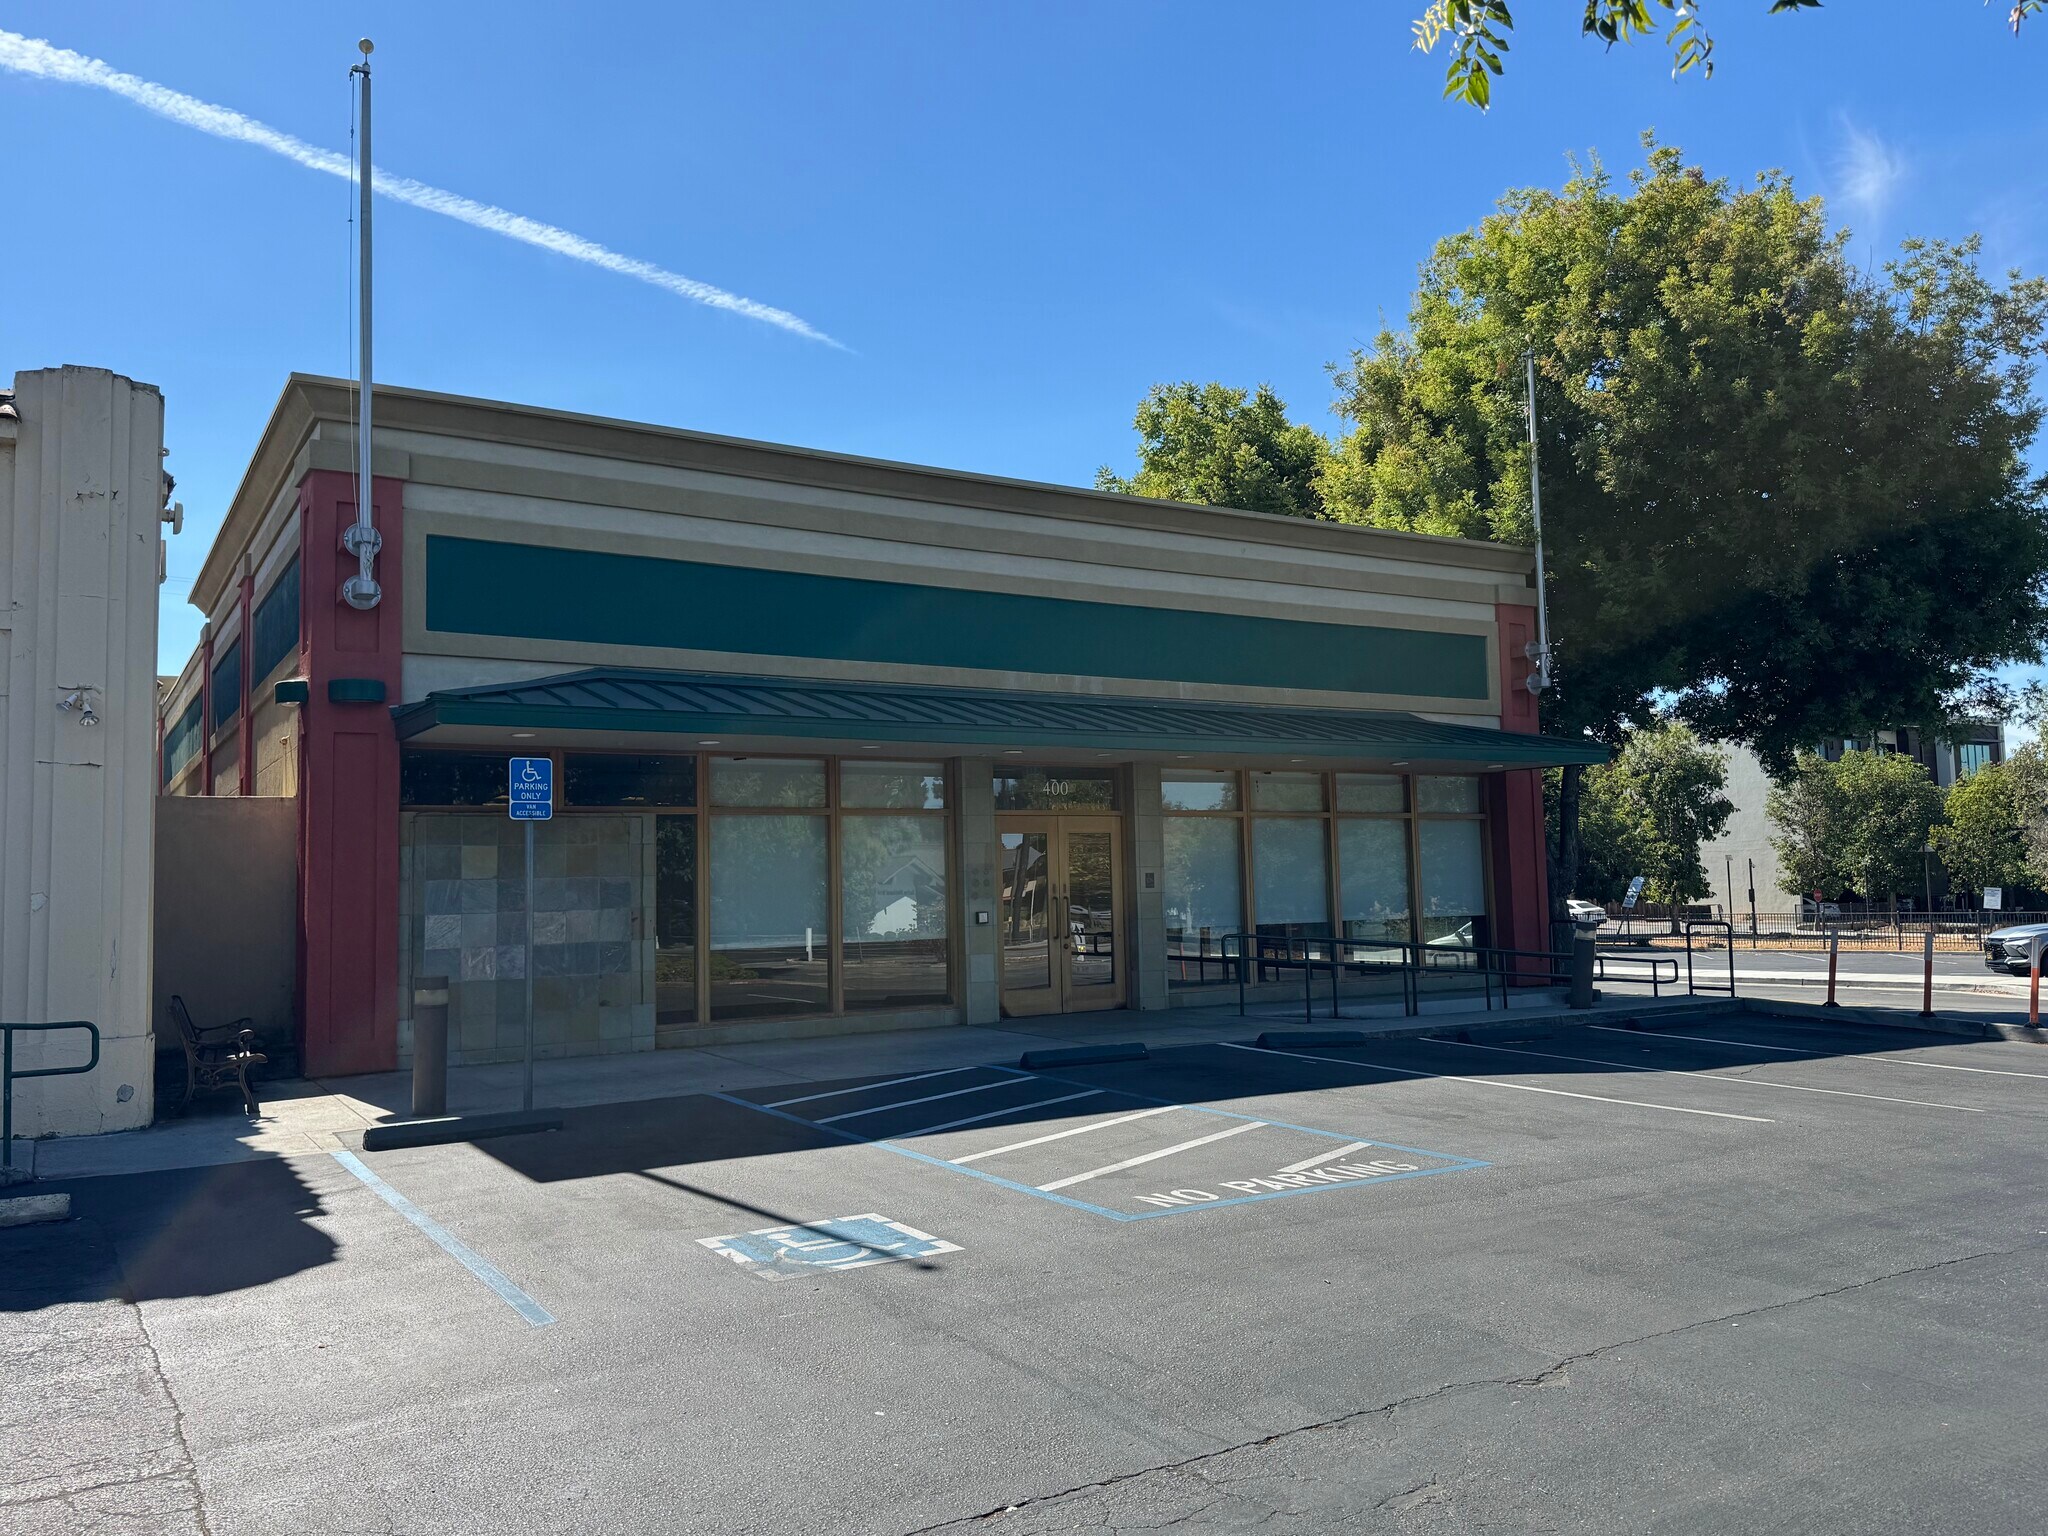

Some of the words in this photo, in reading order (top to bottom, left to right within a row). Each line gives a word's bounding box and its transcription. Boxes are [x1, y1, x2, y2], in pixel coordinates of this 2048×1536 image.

[1043, 781, 1068, 795] 400
[1134, 1189, 1220, 1207] NO
[1218, 1161, 1418, 1193] PARKING
